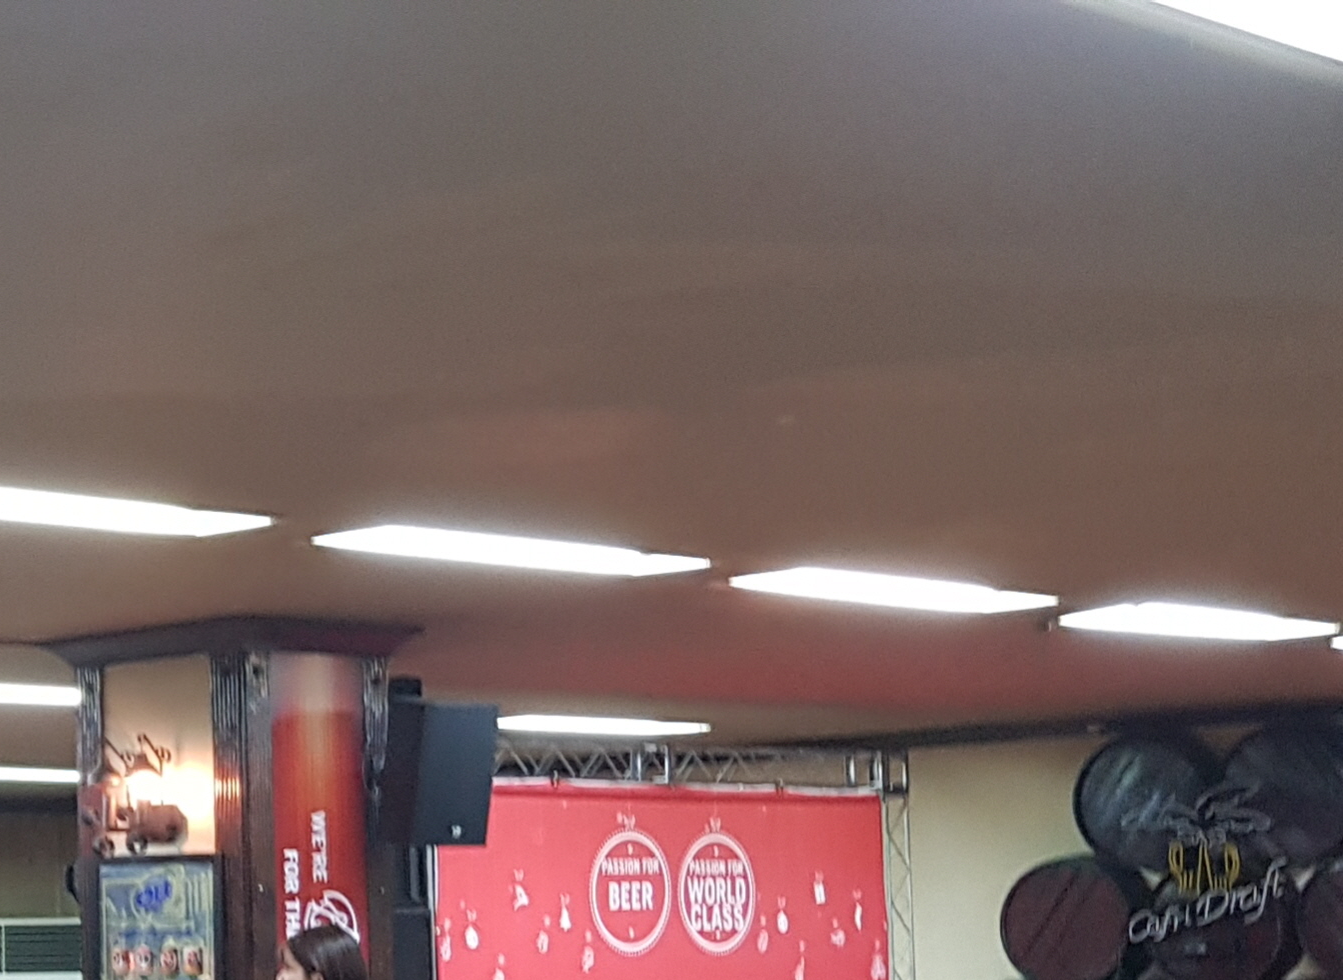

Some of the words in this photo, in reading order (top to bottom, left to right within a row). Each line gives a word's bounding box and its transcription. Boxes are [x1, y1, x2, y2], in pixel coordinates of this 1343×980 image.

[311, 810, 327, 883] WE'RE
[283, 848, 299, 894] FOR
[602, 857, 640, 876] PASSION
[642, 857, 660, 875] FOR
[689, 859, 726, 877] PASSION
[728, 859, 744, 876] FOR
[608, 881, 654, 912] BEER
[687, 876, 747, 906] WORLD
[690, 903, 744, 932] CLASS
